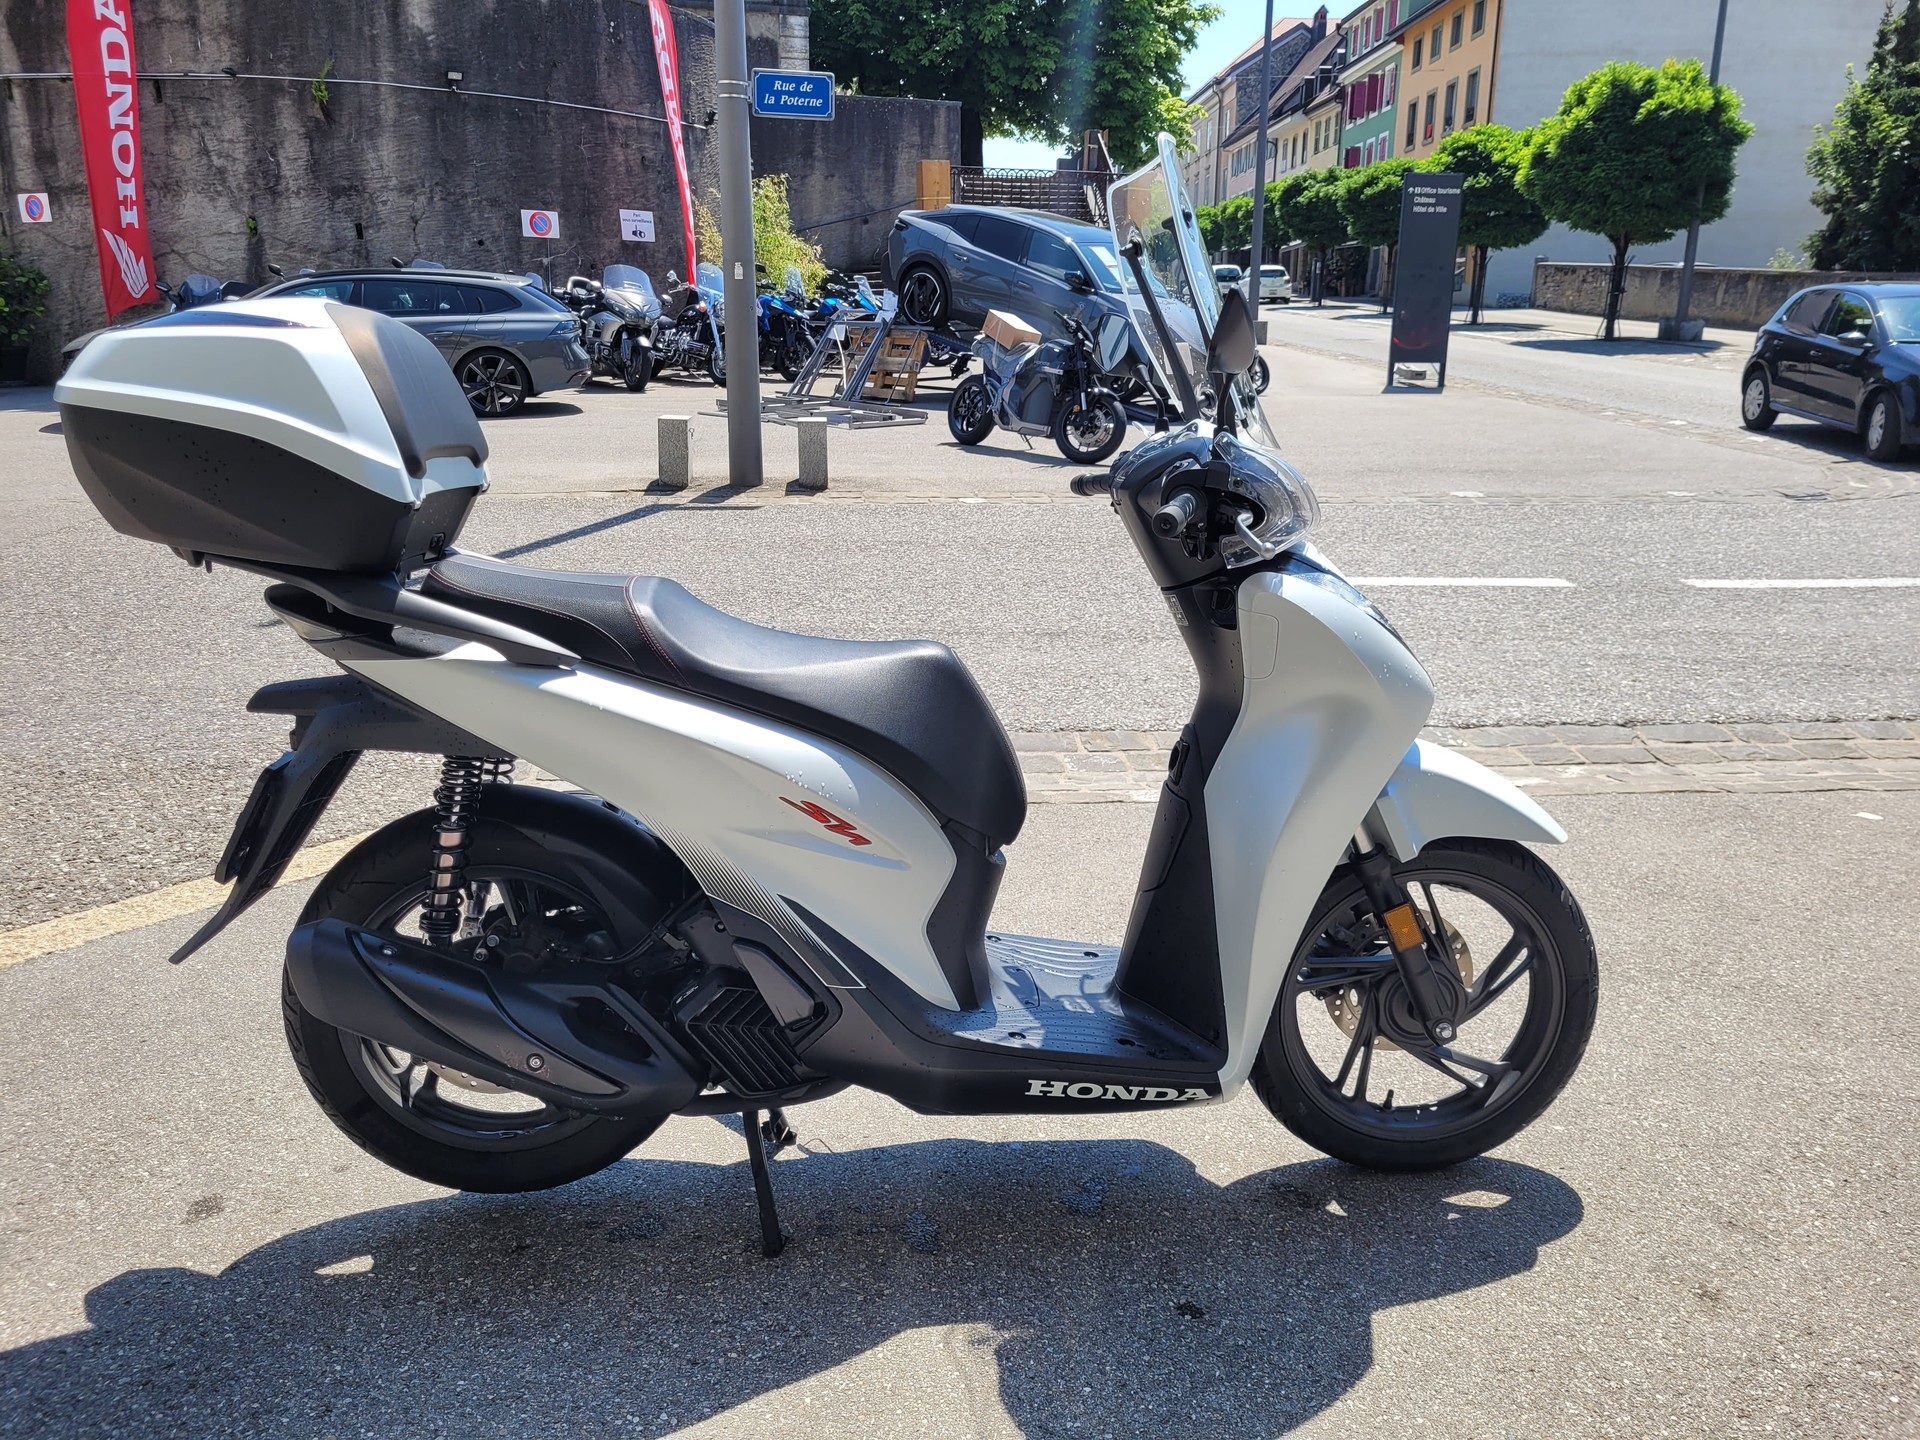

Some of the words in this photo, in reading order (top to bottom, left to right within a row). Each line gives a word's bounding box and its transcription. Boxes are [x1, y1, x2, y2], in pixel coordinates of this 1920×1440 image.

[774, 80, 796, 91] Rue
[800, 81, 814, 92] de
[764, 93, 775, 105] la
[780, 95, 823, 107] Poterne
[1024, 1079, 1213, 1101] HONDA
